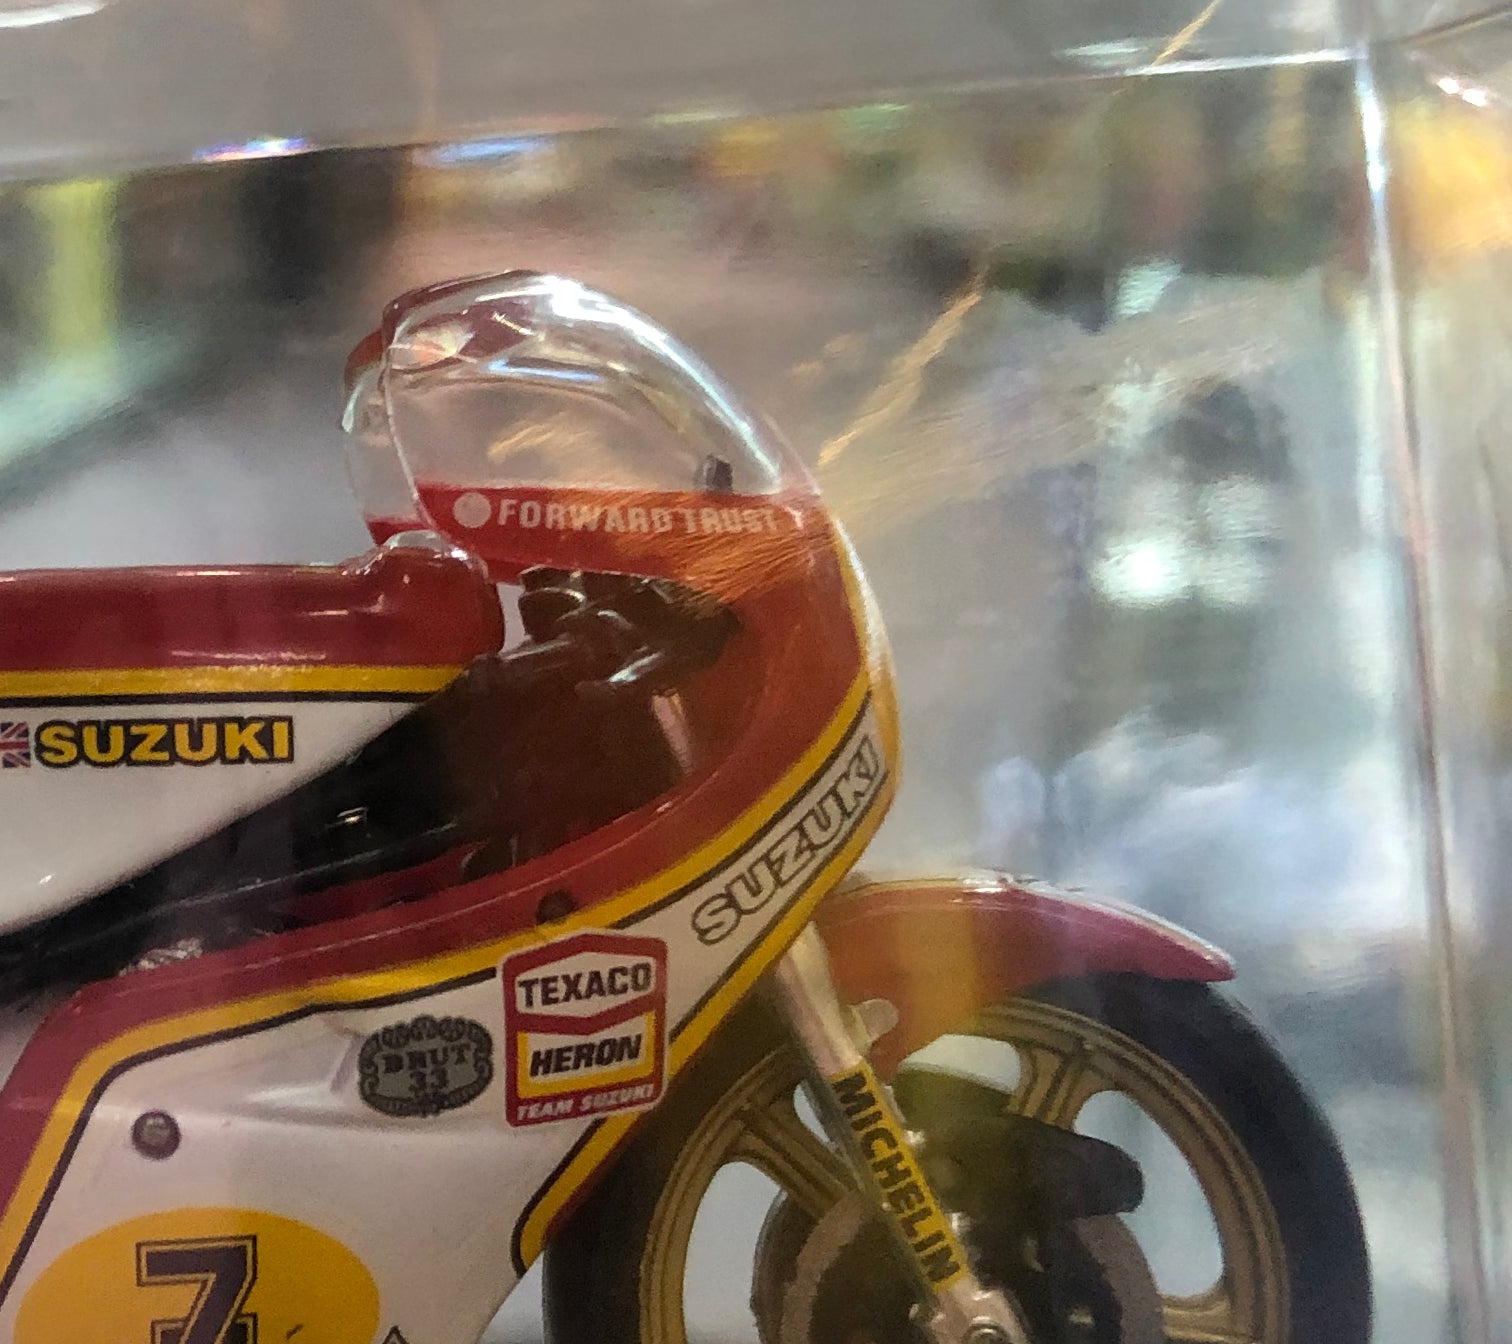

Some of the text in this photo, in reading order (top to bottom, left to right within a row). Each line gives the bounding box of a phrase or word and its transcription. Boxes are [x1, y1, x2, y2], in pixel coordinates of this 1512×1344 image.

[497, 498, 779, 535] FORWARD TRUST
[34, 715, 294, 768] SUZUKI
[691, 734, 880, 946] SUZUKI
[517, 962, 653, 1008] TEXACO
[529, 1032, 643, 1078] HERON
[516, 1083, 655, 1121] TEAM SUZUKI
[834, 1070, 961, 1284] MICHELIN
